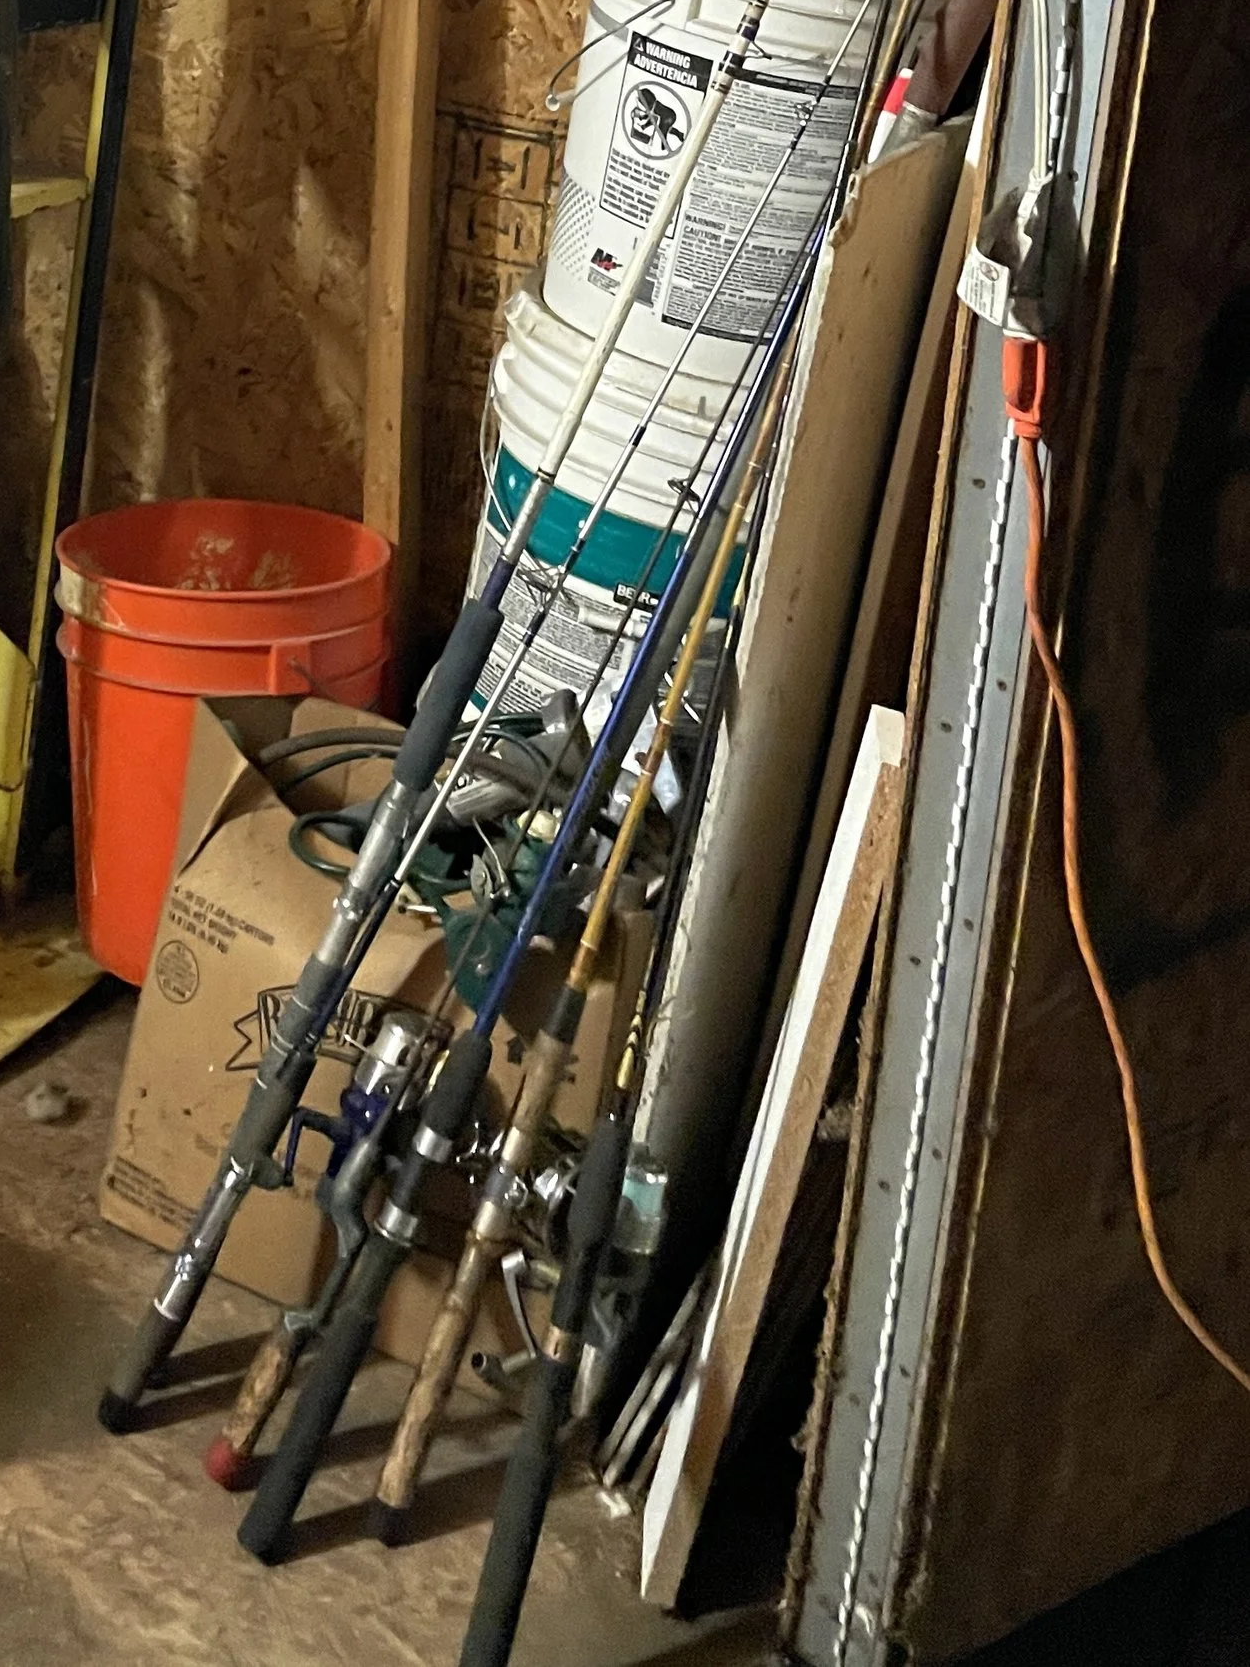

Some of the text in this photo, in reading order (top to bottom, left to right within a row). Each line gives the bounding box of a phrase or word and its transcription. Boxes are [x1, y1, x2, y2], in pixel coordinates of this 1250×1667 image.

[645, 41, 691, 69] WARNING
[633, 53, 698, 89] ADVERTENCIA
[617, 583, 651, 605] BER
